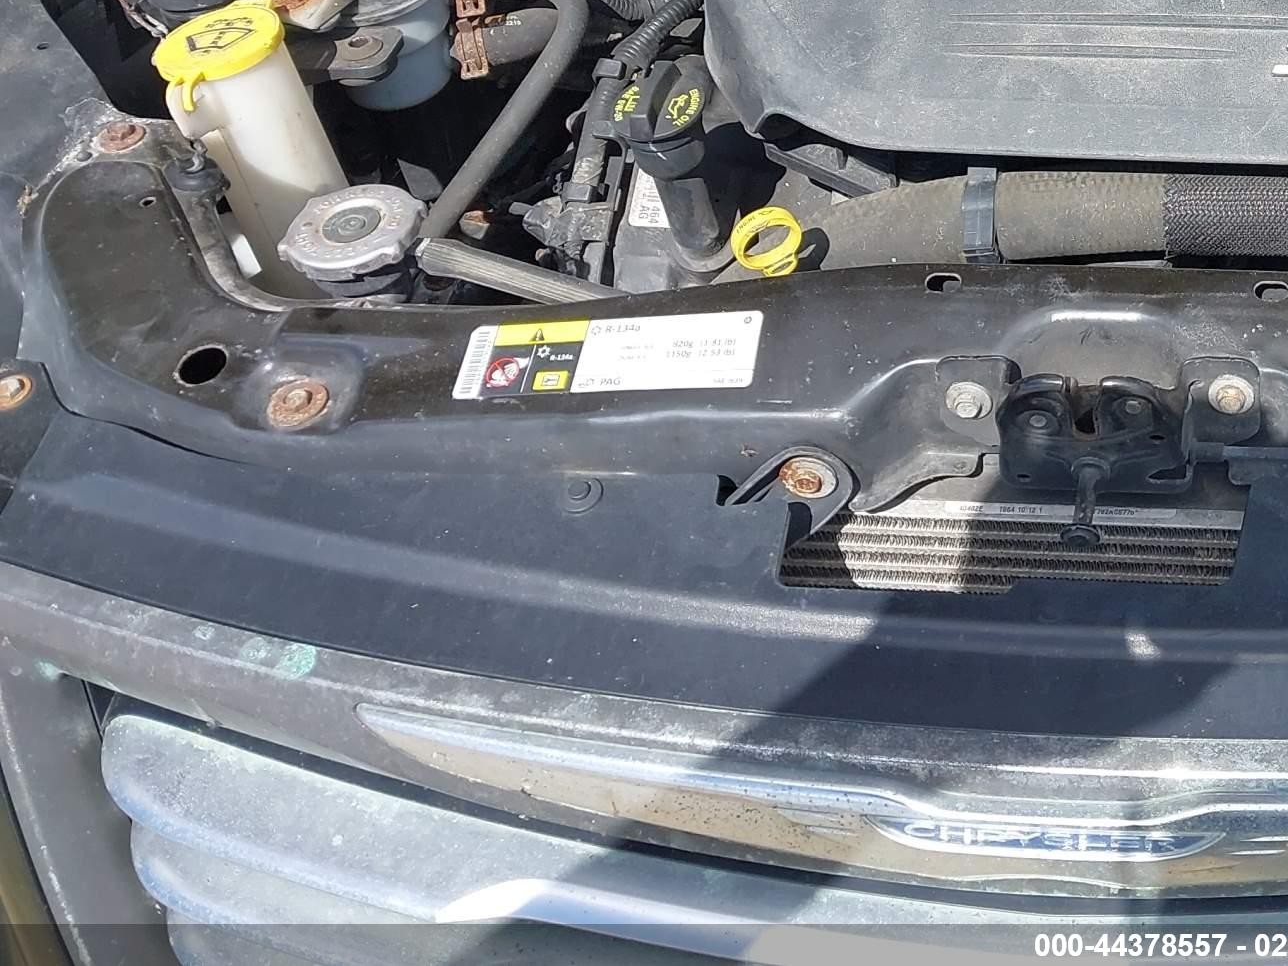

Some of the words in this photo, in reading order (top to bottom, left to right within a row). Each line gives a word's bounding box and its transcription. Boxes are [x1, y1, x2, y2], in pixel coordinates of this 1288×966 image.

[686, 88, 700, 115] ENGINE
[672, 114, 690, 127] OIL
[599, 376, 622, 387] PAG
[903, 819, 1178, 853] CHRYSLER
